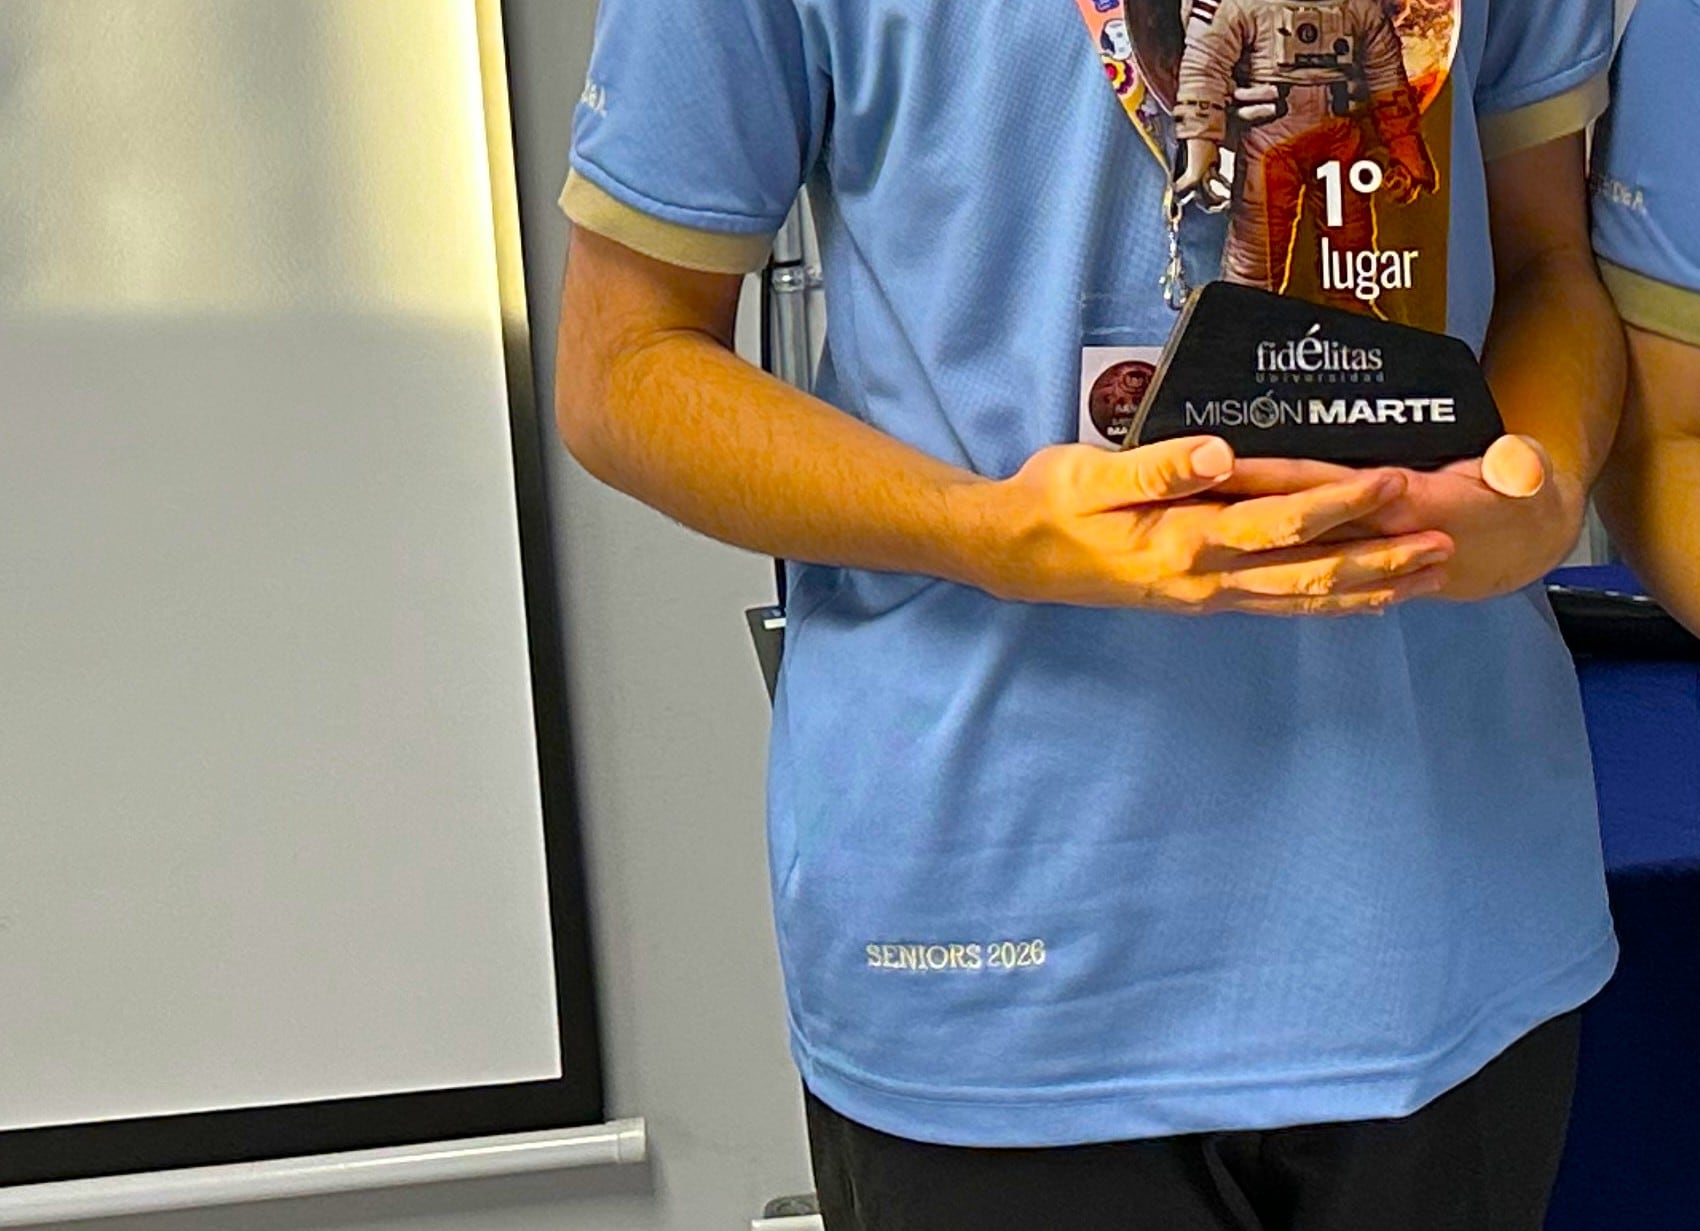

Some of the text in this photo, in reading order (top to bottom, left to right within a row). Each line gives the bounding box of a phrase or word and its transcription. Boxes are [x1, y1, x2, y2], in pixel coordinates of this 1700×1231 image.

[1321, 236, 1419, 300] lugar
[1256, 324, 1384, 372] fidélitas
[1185, 390, 1457, 429] MISIÓN MARTE
[866, 939, 1046, 971] SENIORS 2026
